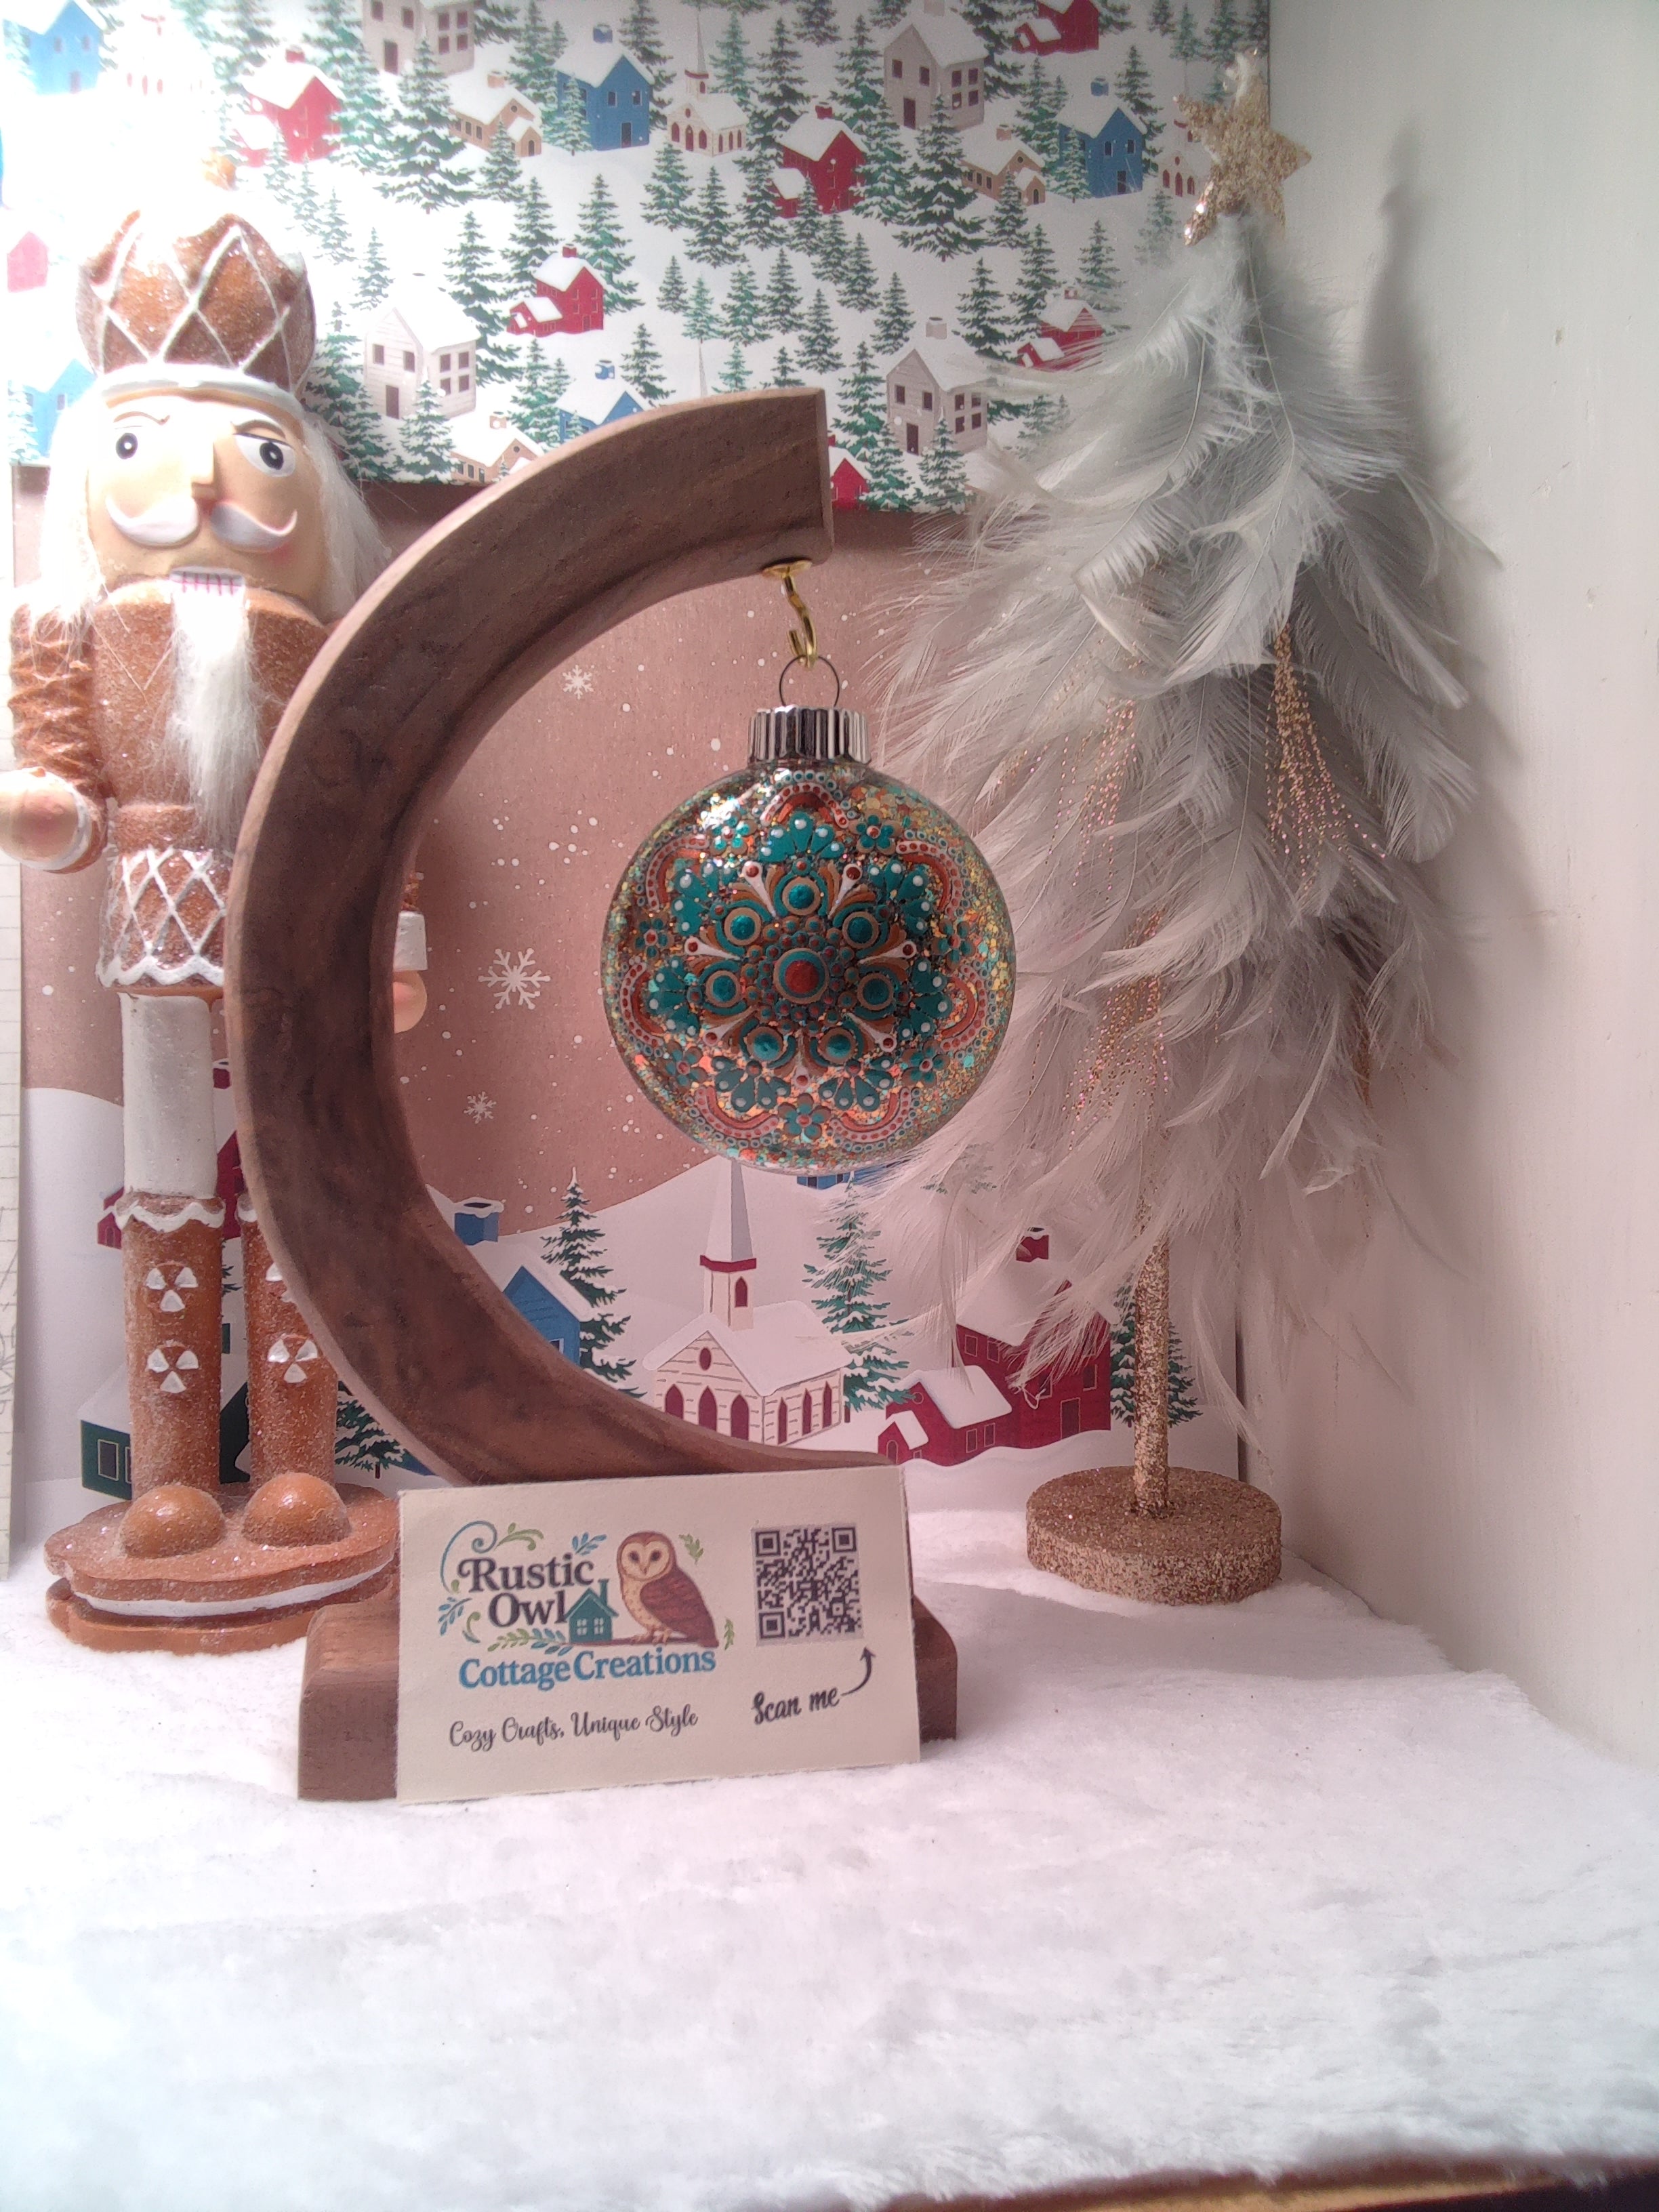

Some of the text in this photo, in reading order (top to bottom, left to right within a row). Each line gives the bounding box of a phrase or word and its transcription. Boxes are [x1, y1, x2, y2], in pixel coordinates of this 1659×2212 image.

[457, 1553, 594, 1593] Rustic
[488, 1591, 568, 1628] Owl
[751, 1687, 840, 1725] Scan me
[449, 1704, 698, 1752] Cozy Crafts, Unique Style
